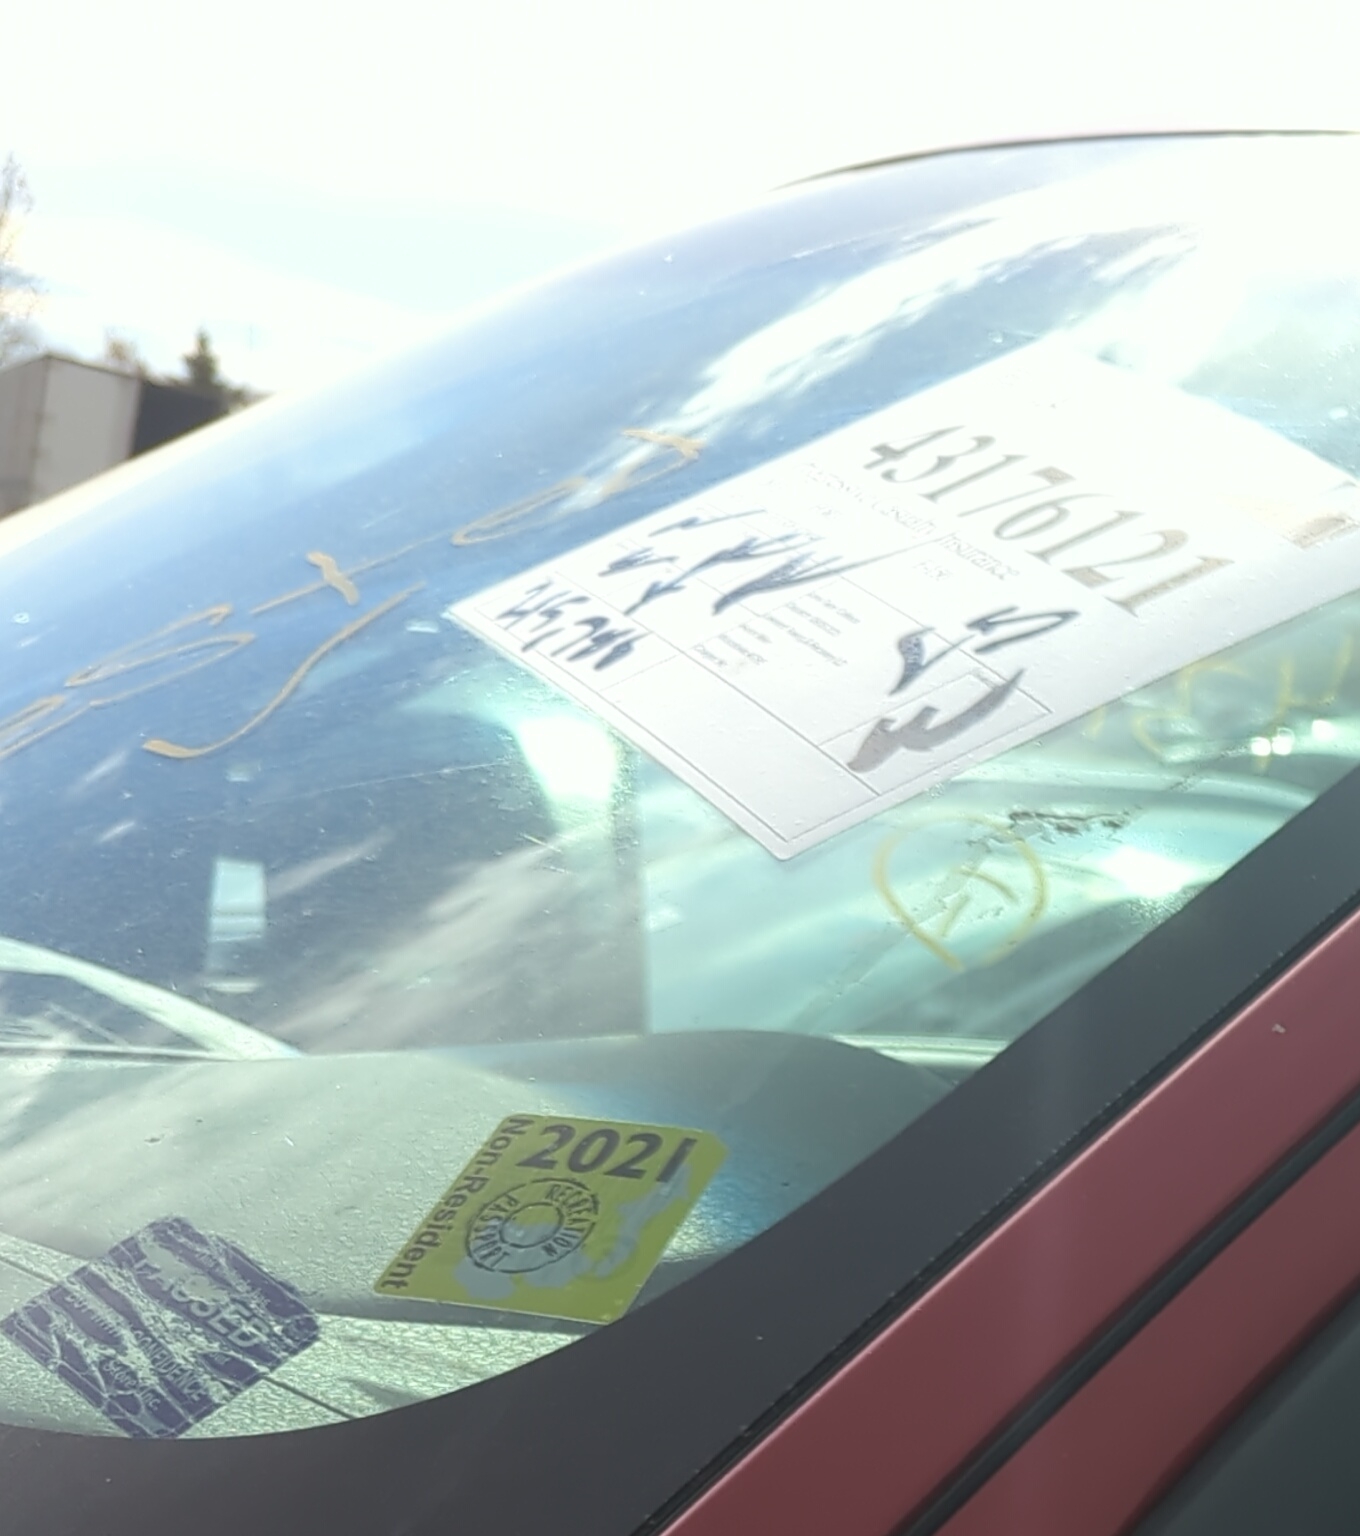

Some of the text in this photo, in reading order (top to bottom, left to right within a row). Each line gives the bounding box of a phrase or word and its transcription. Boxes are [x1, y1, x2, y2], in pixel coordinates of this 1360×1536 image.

[860, 423, 1240, 618] 43176121
[931, 529, 1028, 585] Insurance
[515, 1123, 700, 1184] 2021
[379, 1116, 536, 1291] Non-Resident
[471, 1189, 525, 1270] PASSPORT
[133, 1328, 208, 1403] CONFIDENCE
